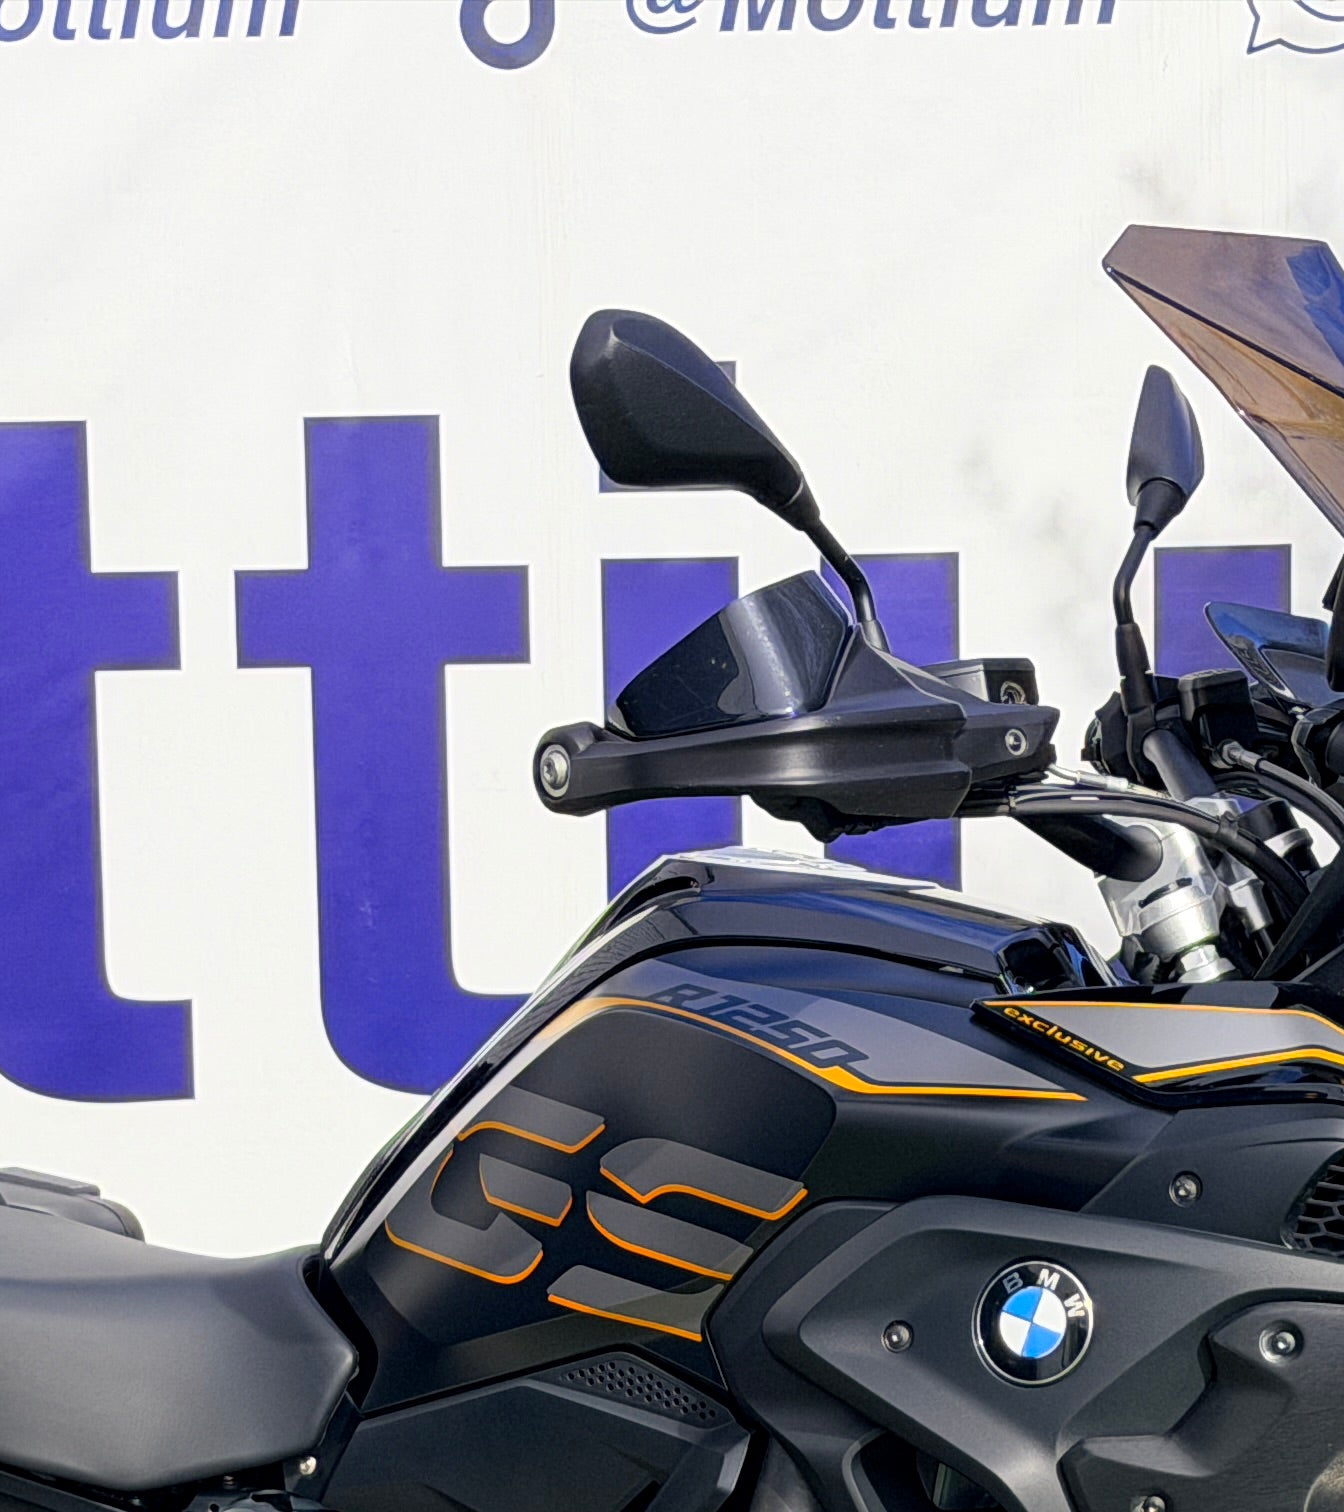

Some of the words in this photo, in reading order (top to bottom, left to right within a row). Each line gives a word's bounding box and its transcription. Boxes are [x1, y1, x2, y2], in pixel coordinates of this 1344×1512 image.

[652, 983, 870, 1068] R1250
[1003, 1006, 1125, 1073] exclusive
[384, 1085, 808, 1343] GS
[1002, 1268, 1086, 1318] BMW
